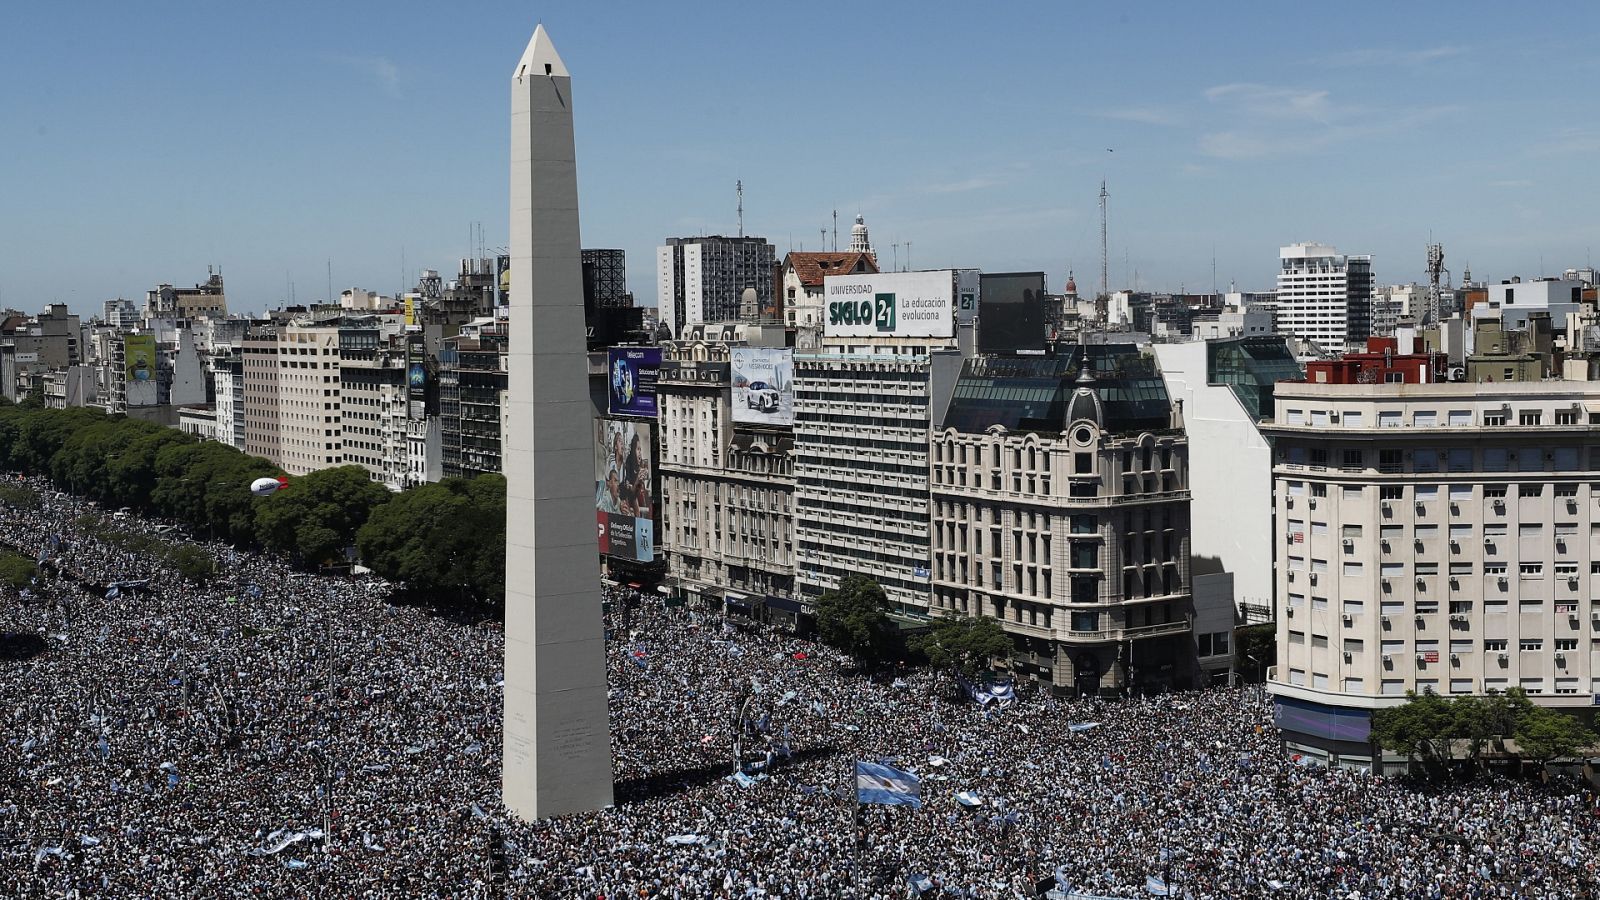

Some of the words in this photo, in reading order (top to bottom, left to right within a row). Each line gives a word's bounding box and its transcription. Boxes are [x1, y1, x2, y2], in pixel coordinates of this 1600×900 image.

[830, 284, 873, 295] UNIVERSIDAD
[902, 298, 910, 308] La
[911, 297, 946, 308] educación
[962, 296, 974, 310] 21
[829, 300, 873, 326] SIGLO
[877, 299, 892, 327] 21
[902, 310, 939, 321] evoluciona
[626, 351, 645, 359] telecom
